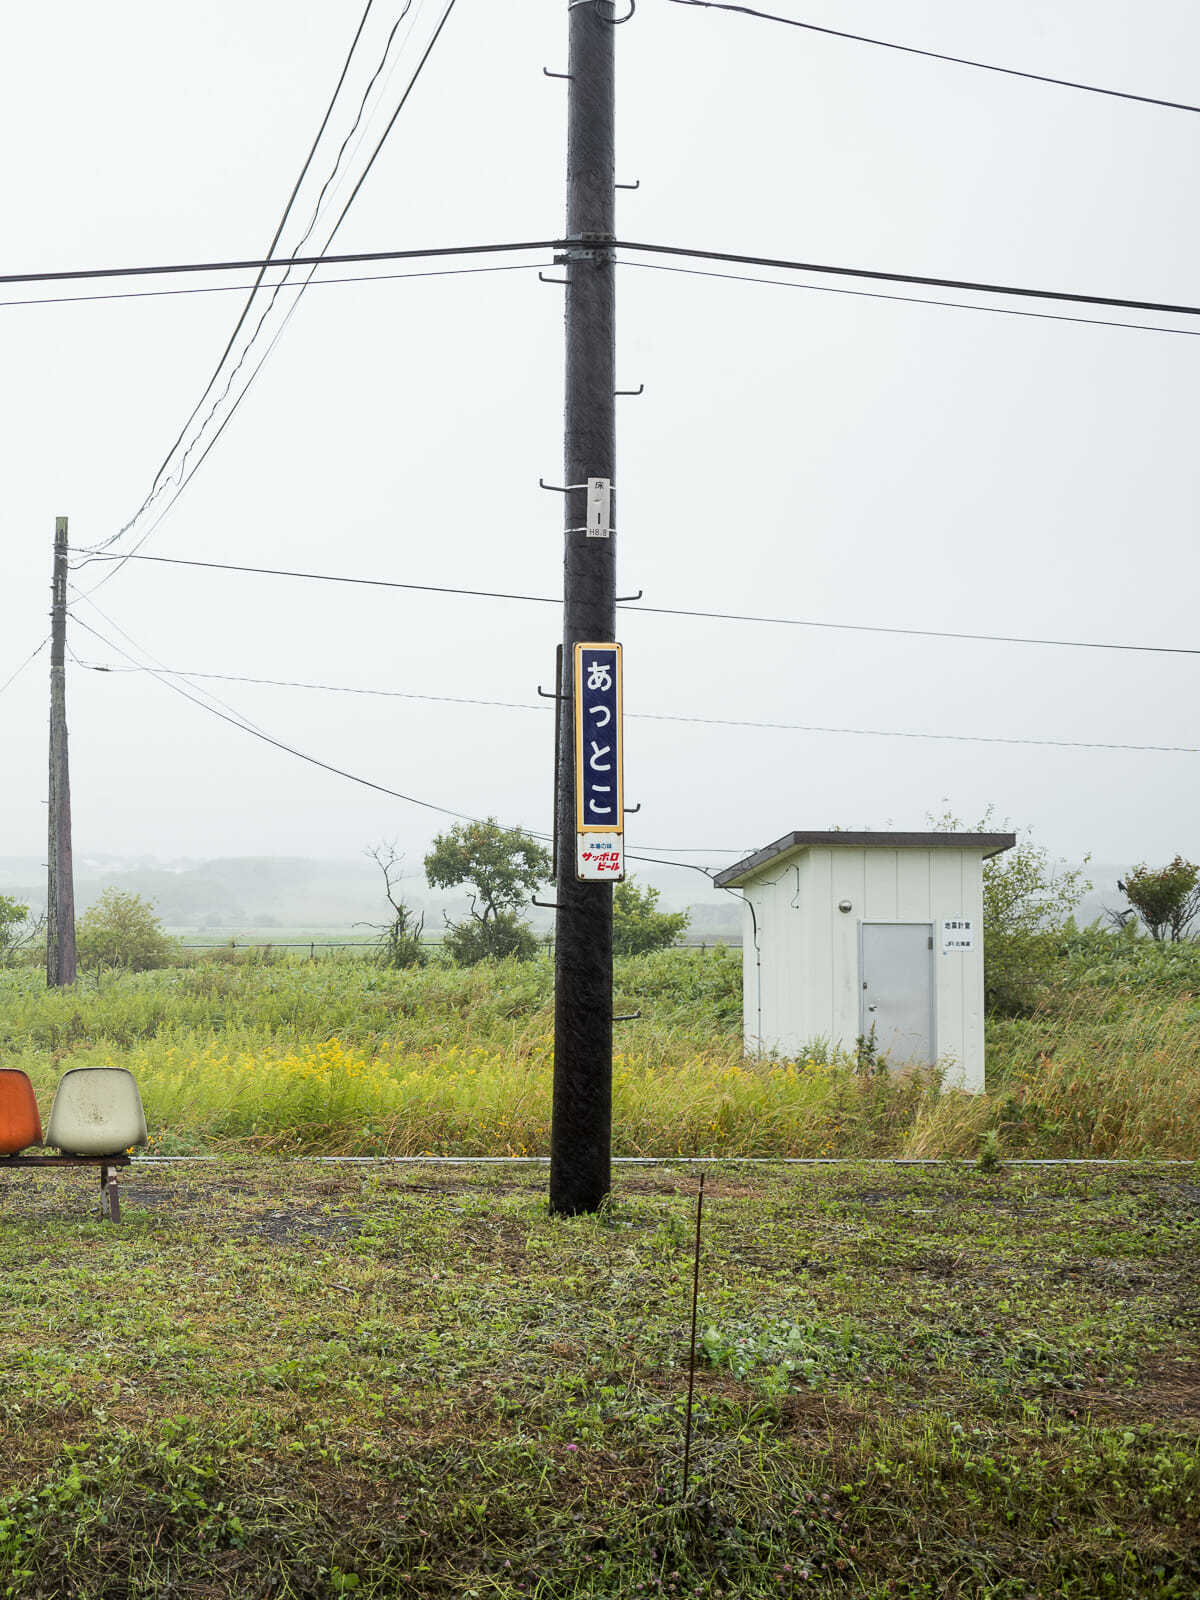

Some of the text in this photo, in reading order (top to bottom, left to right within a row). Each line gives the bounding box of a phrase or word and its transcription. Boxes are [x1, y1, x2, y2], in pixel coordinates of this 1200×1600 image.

[587, 662, 612, 814] あっとこ
[582, 852, 620, 861] サッポロ
[597, 862, 620, 871] ビール
